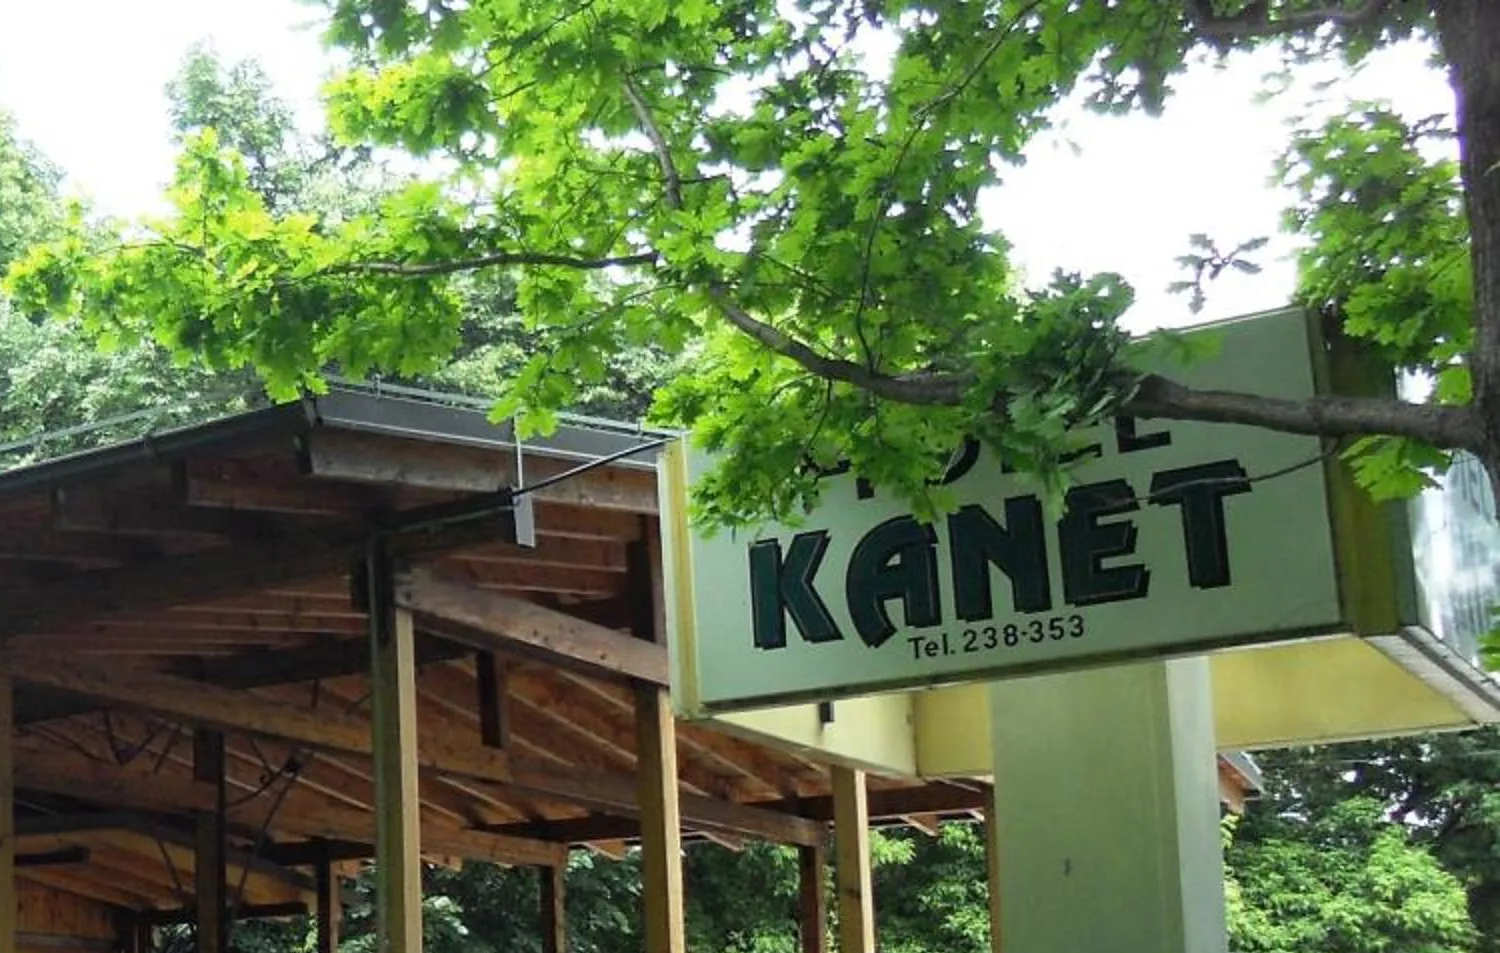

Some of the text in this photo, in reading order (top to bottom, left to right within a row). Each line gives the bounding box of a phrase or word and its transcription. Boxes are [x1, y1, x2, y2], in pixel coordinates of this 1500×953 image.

[747, 458, 1252, 650] KANET
[907, 614, 1085, 660] Tel. 238-353
